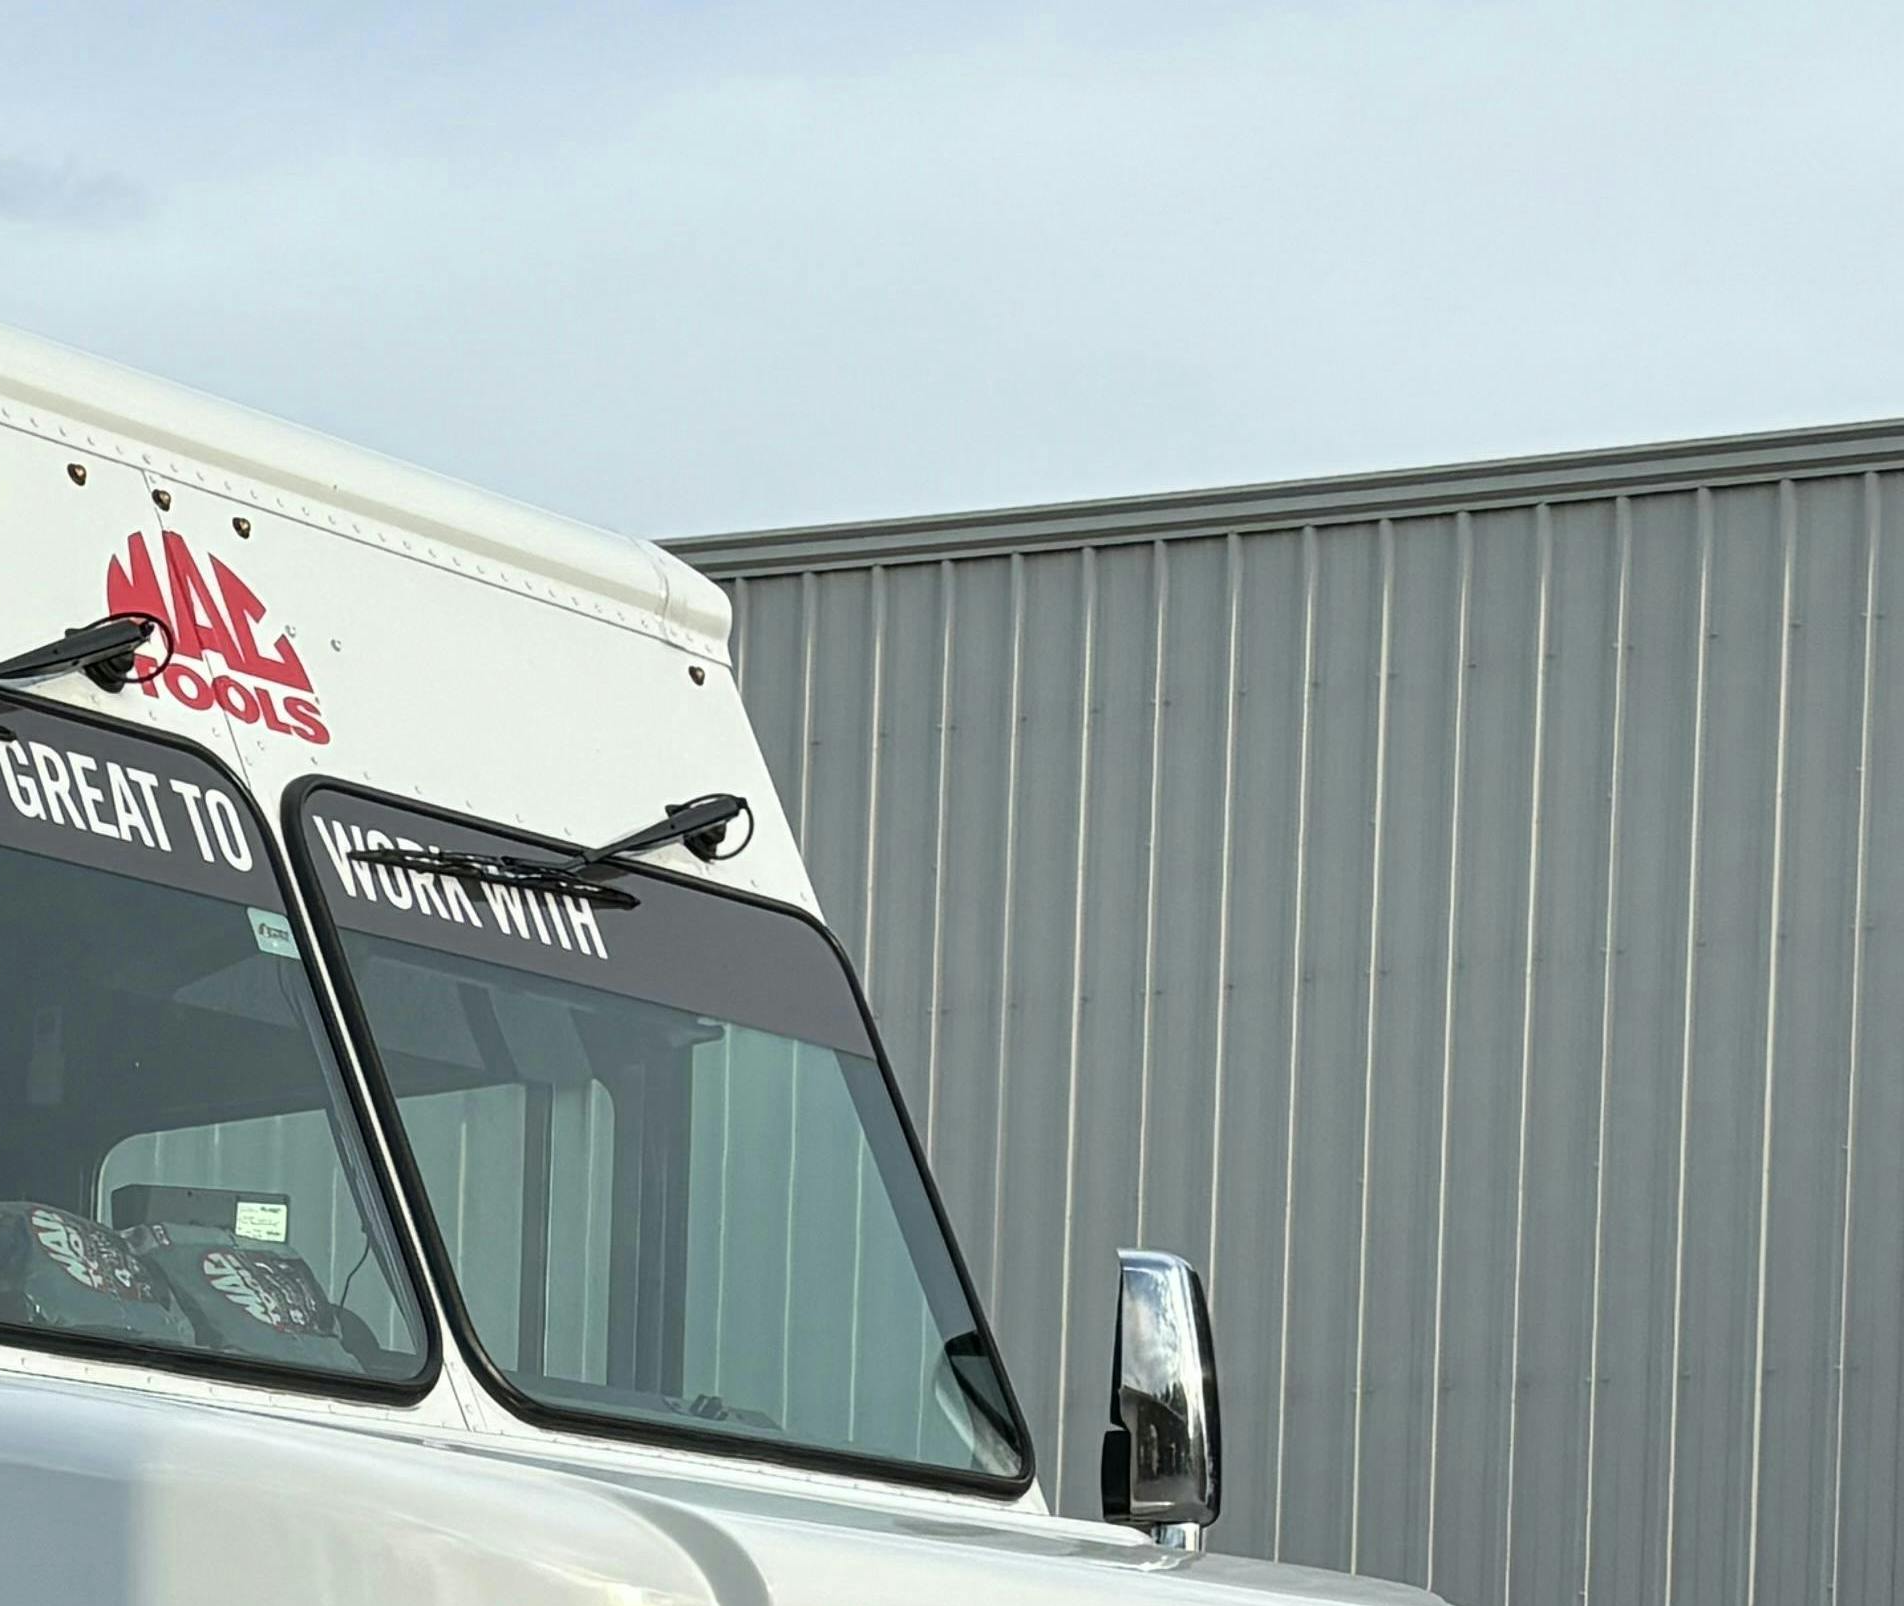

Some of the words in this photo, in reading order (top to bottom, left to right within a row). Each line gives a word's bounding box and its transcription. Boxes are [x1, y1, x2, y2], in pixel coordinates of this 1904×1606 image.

[107, 529, 314, 694] MAC
[134, 653, 330, 745] TOOLS
[169, 779, 254, 873] TO
[312, 815, 484, 929] WORK
[203, 1252, 273, 1326] MAC
